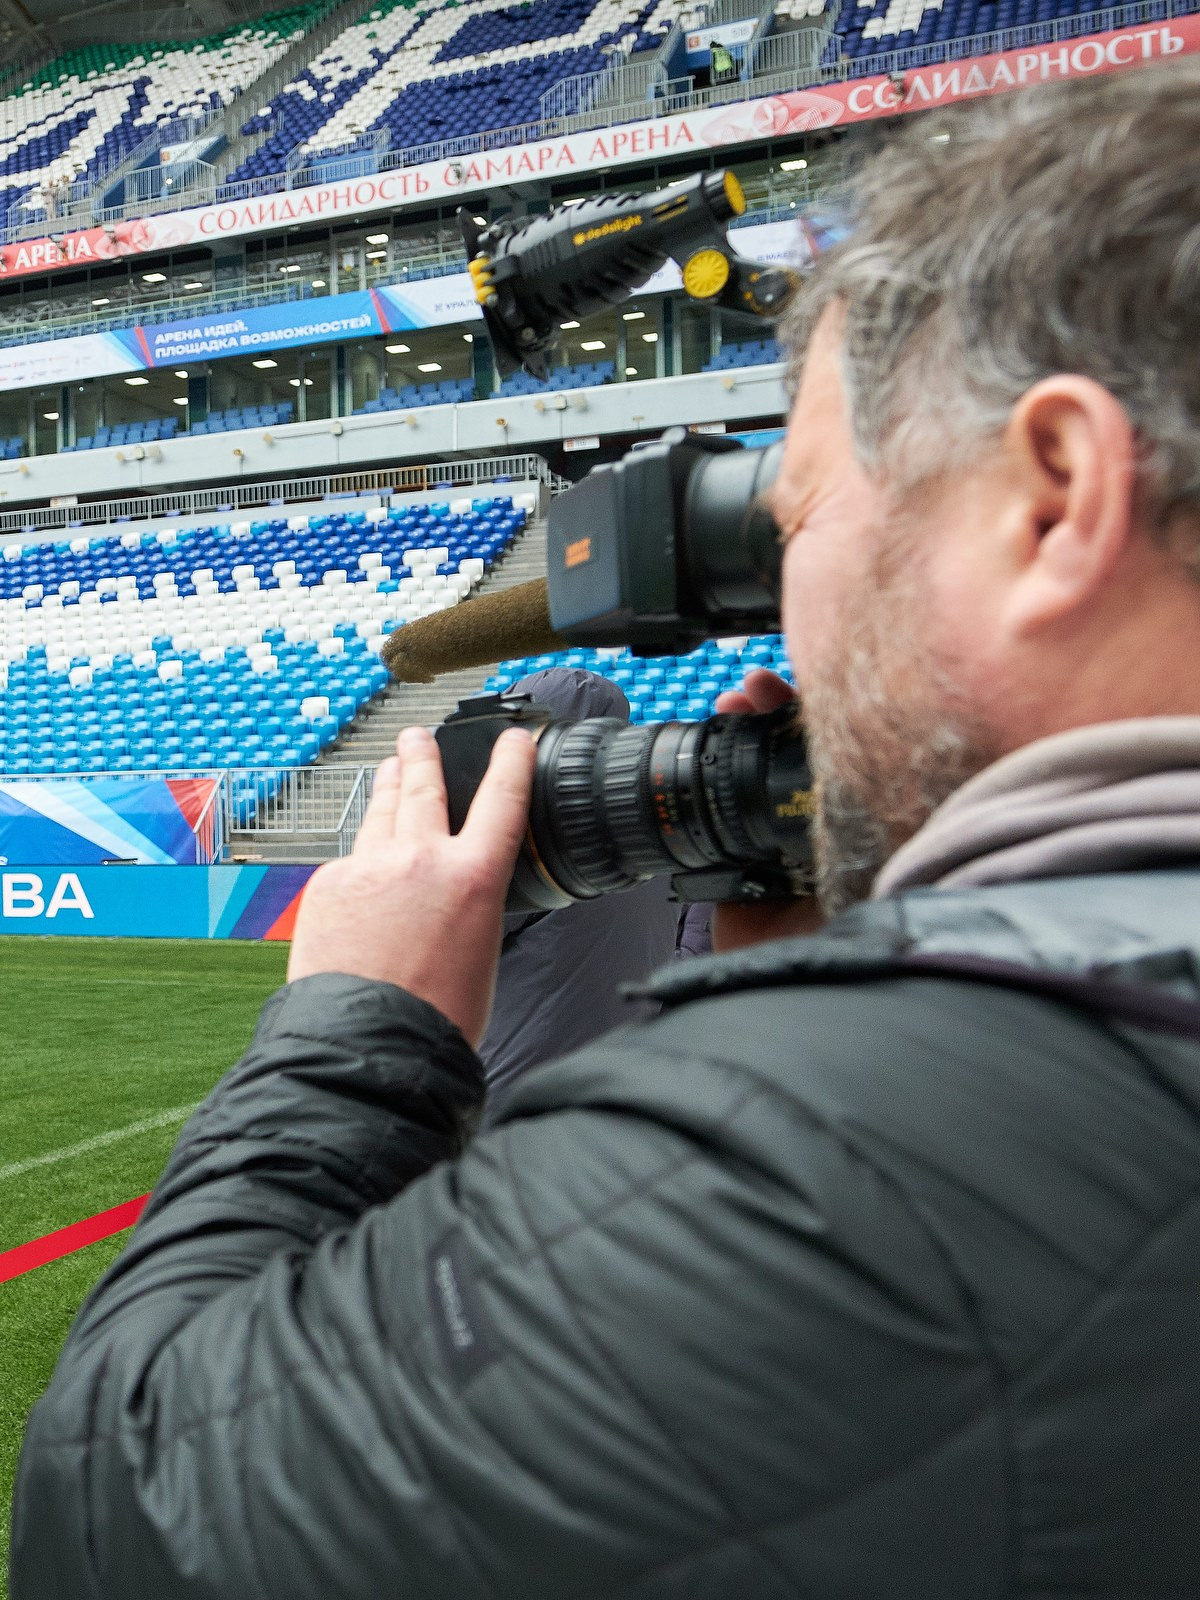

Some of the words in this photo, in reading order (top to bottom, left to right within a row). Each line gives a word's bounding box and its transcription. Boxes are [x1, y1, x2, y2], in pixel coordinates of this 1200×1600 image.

[200, 172, 430, 233] СОЛИДАРНОСТЬ
[443, 147, 576, 187] САМАРА
[590, 121, 695, 158] АРЕНА
[14, 236, 93, 270] АРЕНА
[154, 330, 202, 345] АРЕНА
[155, 337, 239, 359] ПЛОЩАДКА
[240, 313, 372, 346] ВОЗМОЖНОСТЕЙ
